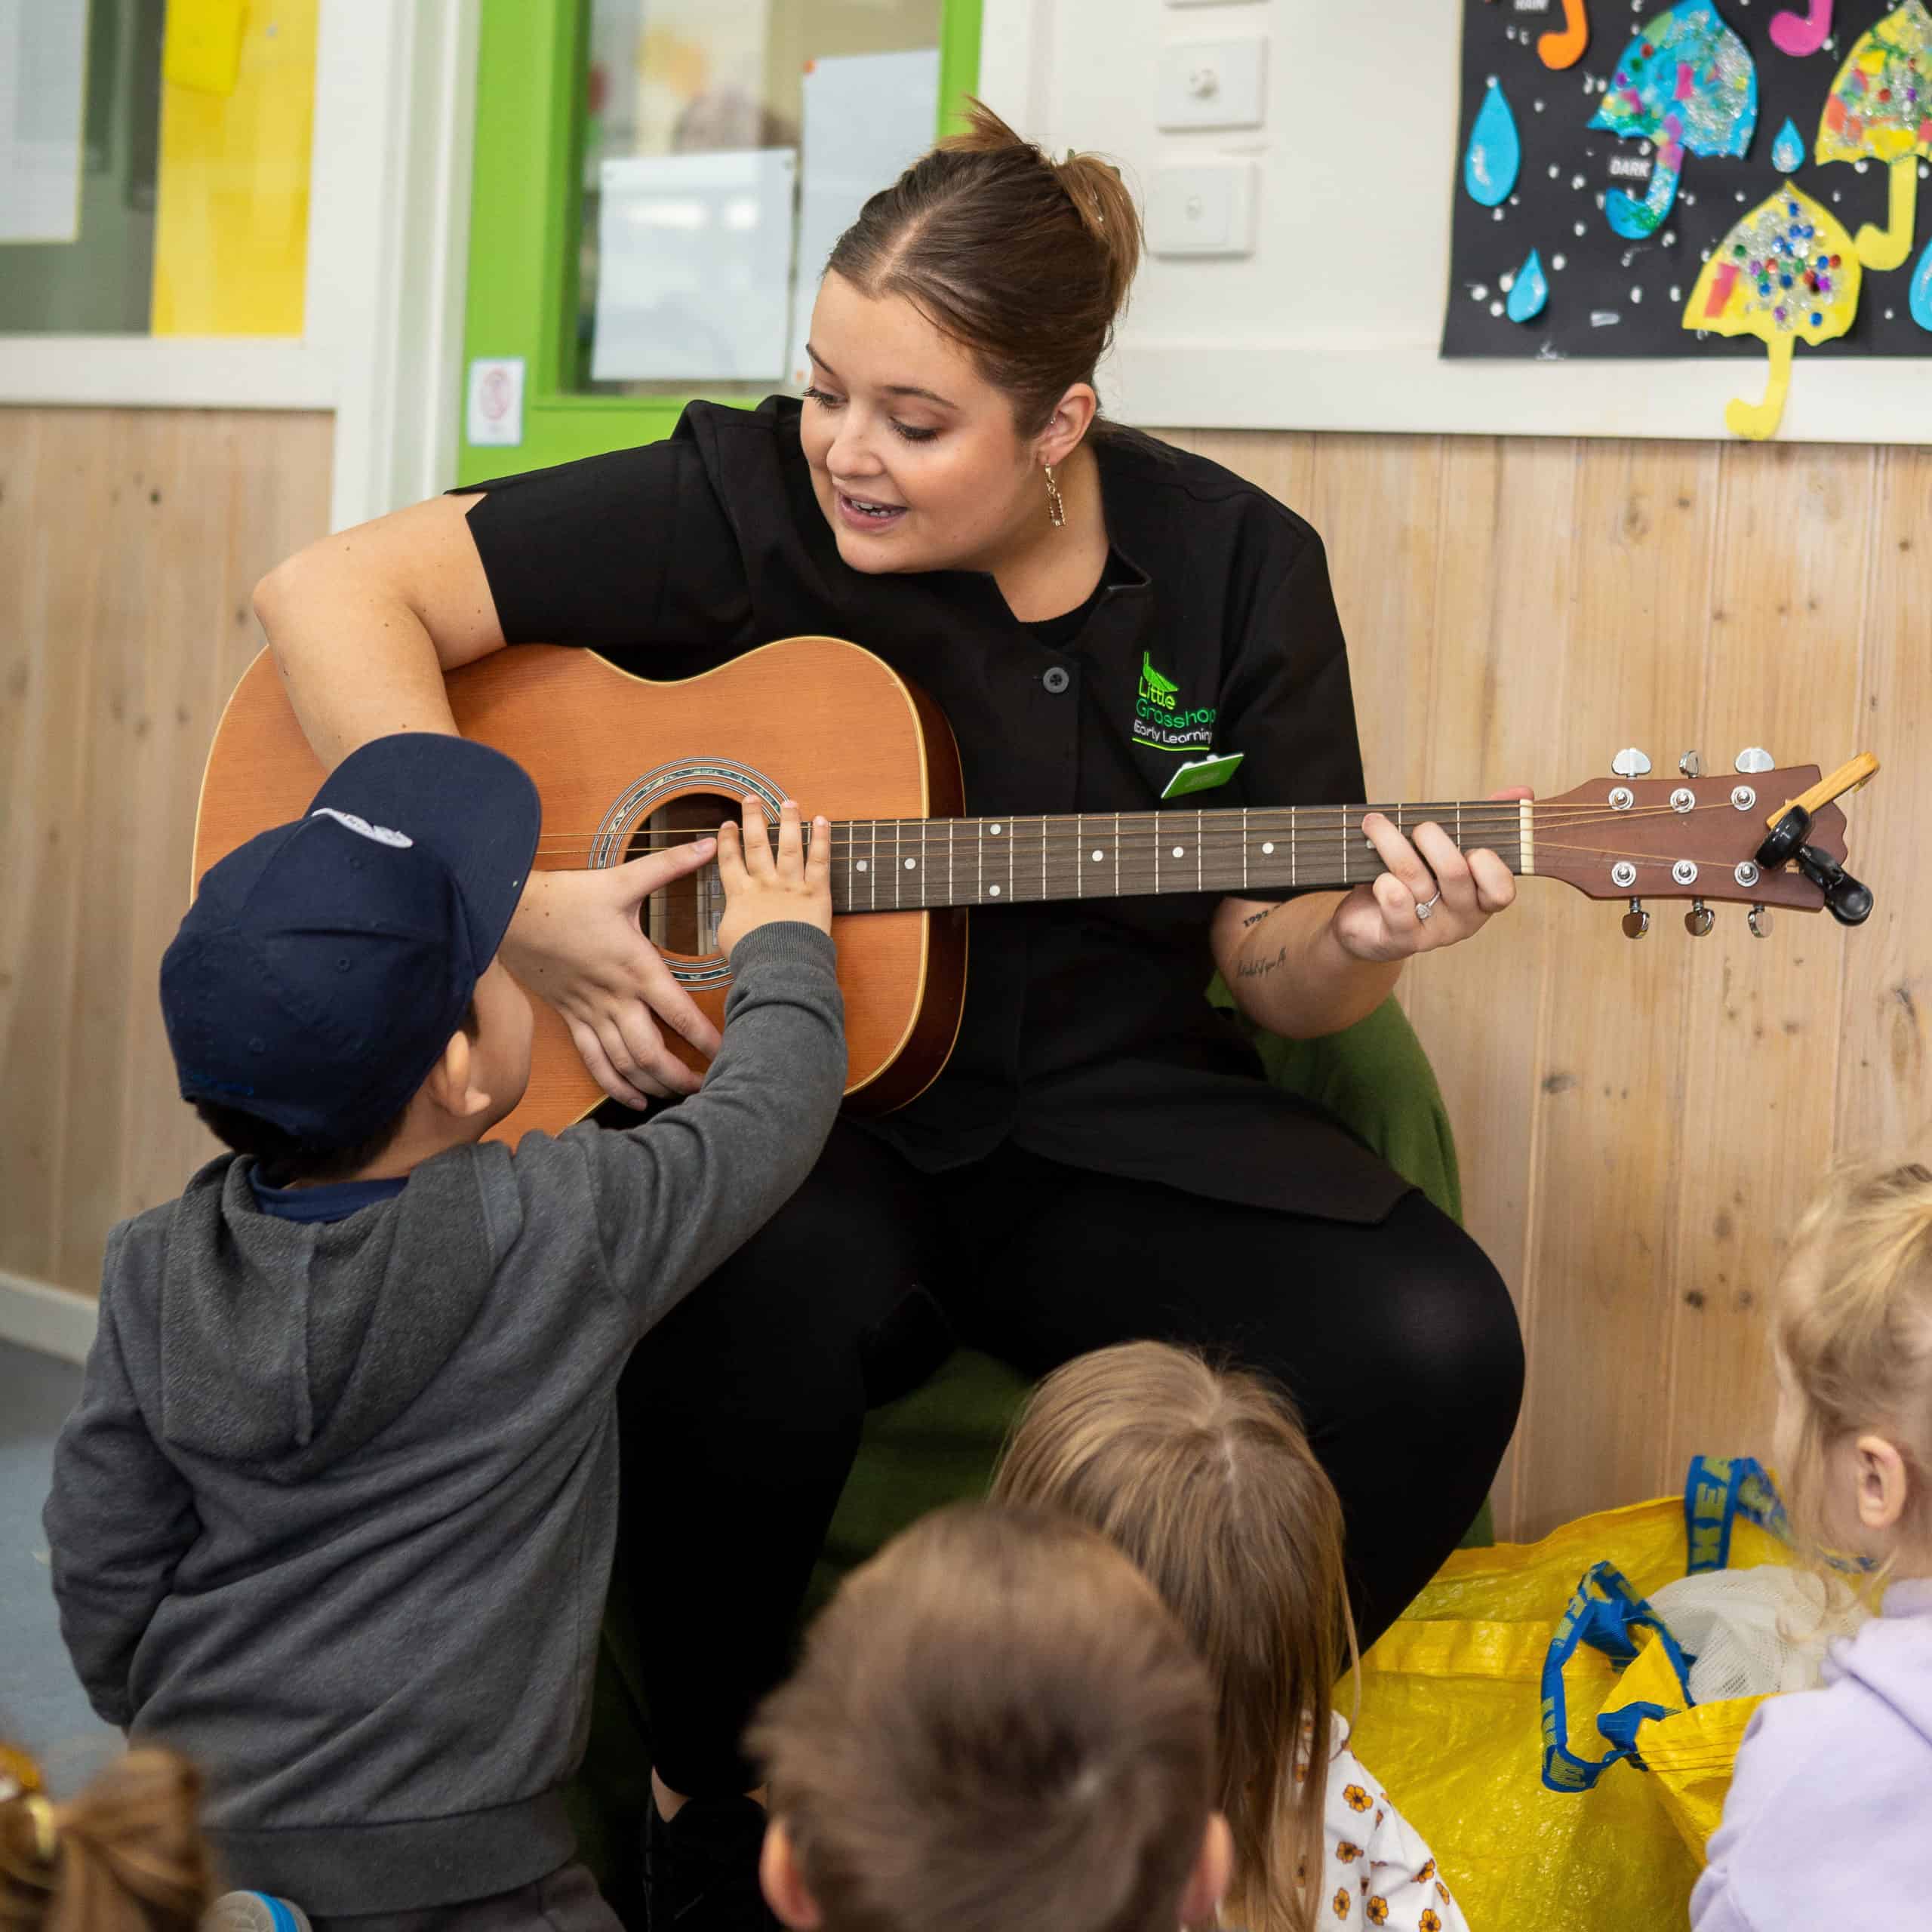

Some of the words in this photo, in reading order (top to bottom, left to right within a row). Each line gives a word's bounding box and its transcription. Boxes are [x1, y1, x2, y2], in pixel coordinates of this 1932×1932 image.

[1609, 158, 1651, 177] DARK
[1139, 676, 1176, 709] Little
[1134, 719, 1161, 741] Early
[1690, 1455, 1732, 1576] KEA
